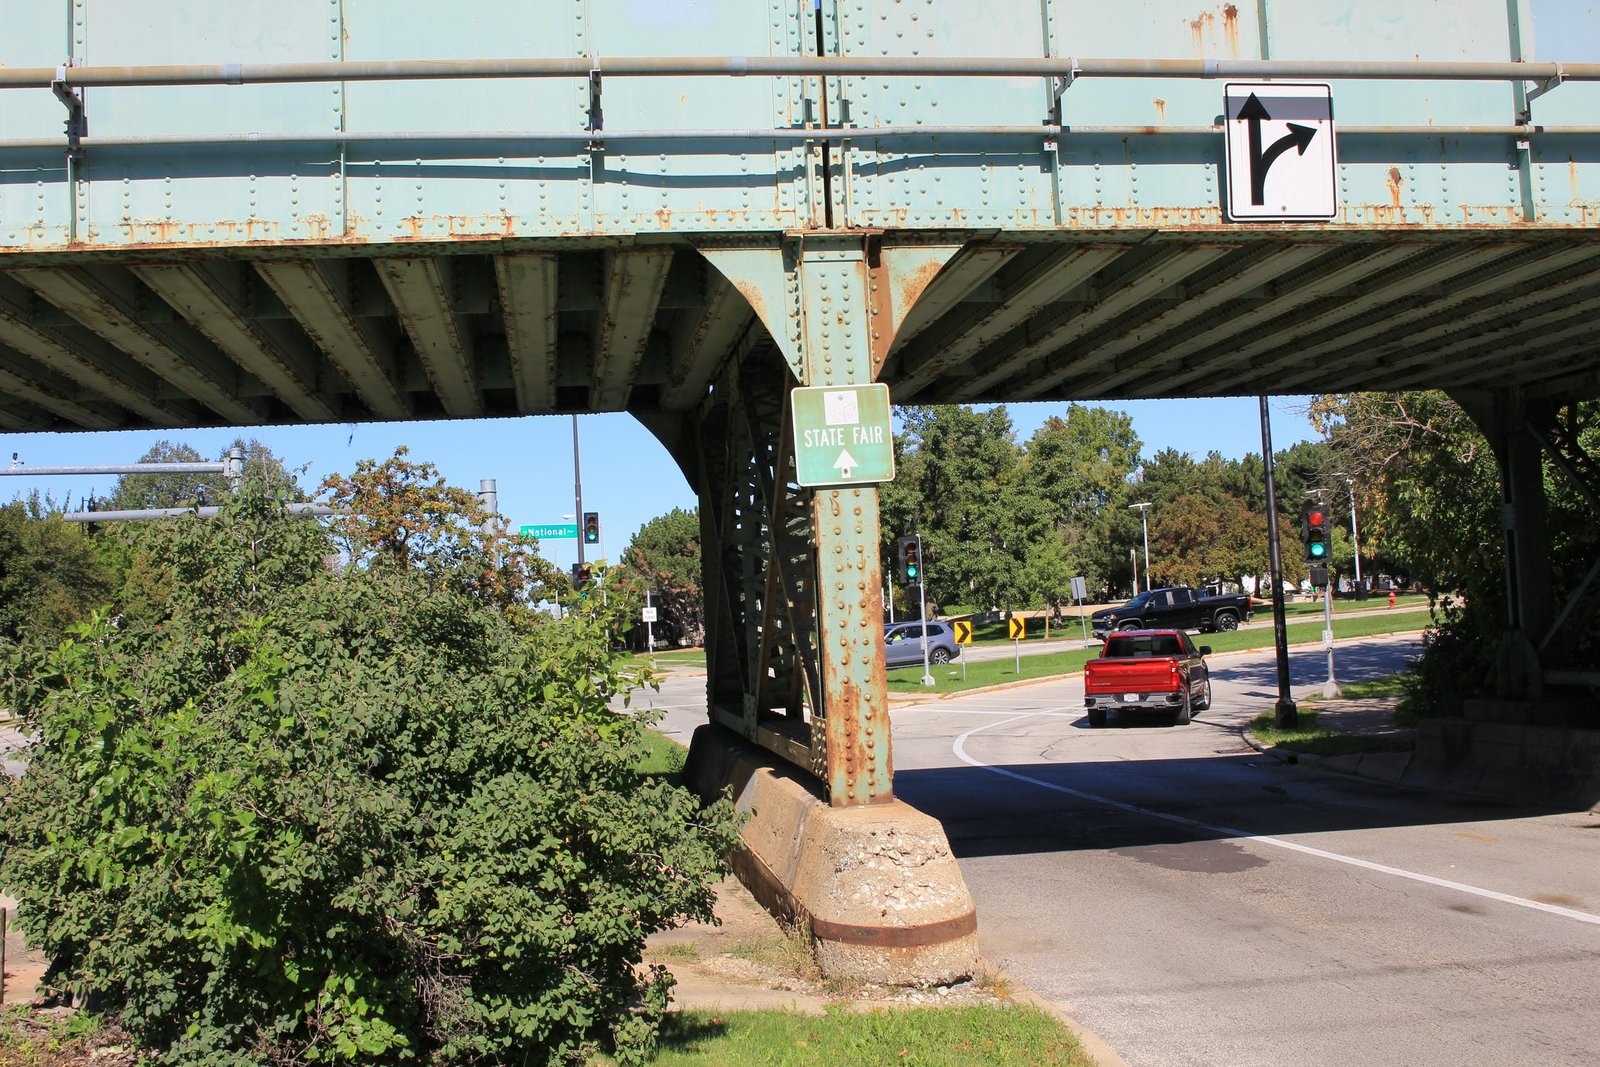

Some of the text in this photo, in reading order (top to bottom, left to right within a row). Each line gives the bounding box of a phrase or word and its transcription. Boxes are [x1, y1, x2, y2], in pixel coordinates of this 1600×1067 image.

[804, 426, 883, 448] STATE FAIR
[527, 527, 567, 537] National
